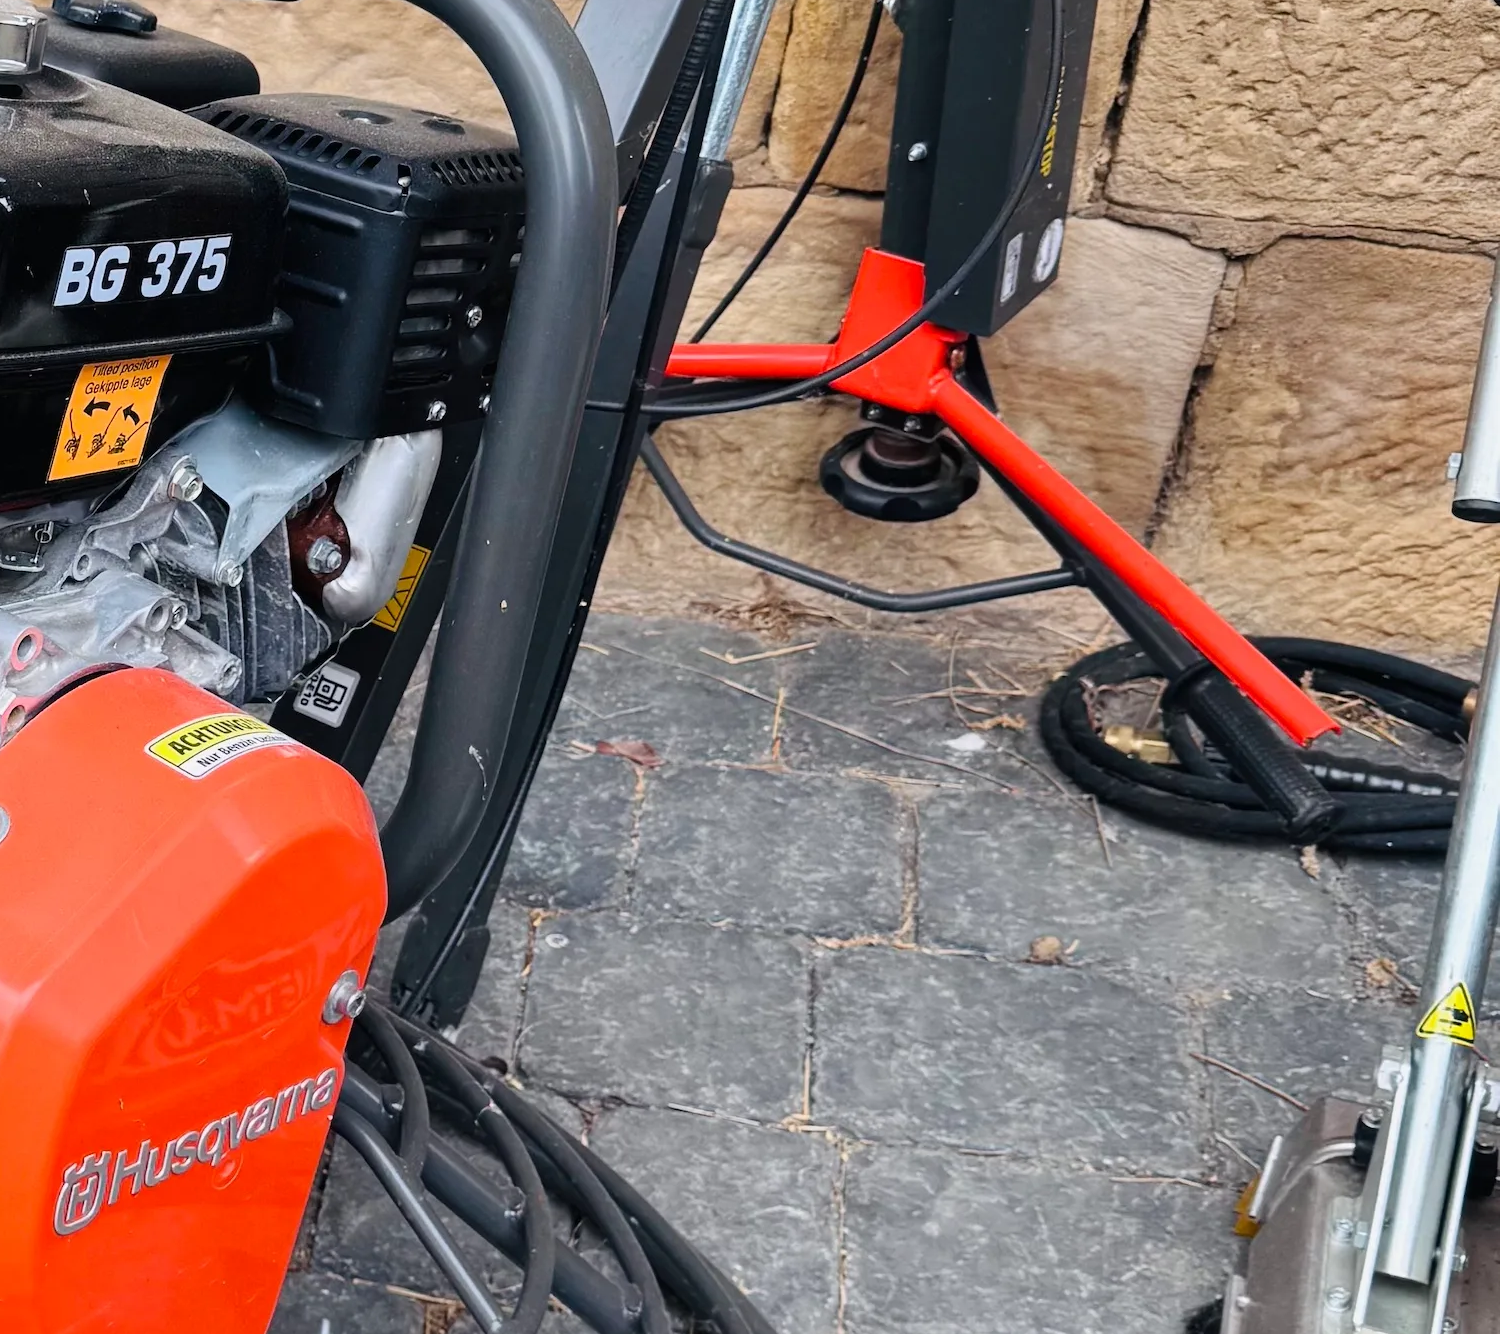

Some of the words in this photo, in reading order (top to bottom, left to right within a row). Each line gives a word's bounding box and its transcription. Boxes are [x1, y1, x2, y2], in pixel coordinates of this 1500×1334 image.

[53, 245, 131, 307] BG
[140, 236, 232, 299] 375
[92, 362, 120, 378] Tilted
[119, 358, 160, 376] position
[85, 380, 129, 395] Gekippte
[129, 374, 152, 390] lage
[196, 750, 220, 768] Nur
[222, 736, 255, 756] Benzin
[107, 1067, 337, 1205] Husqvarna
